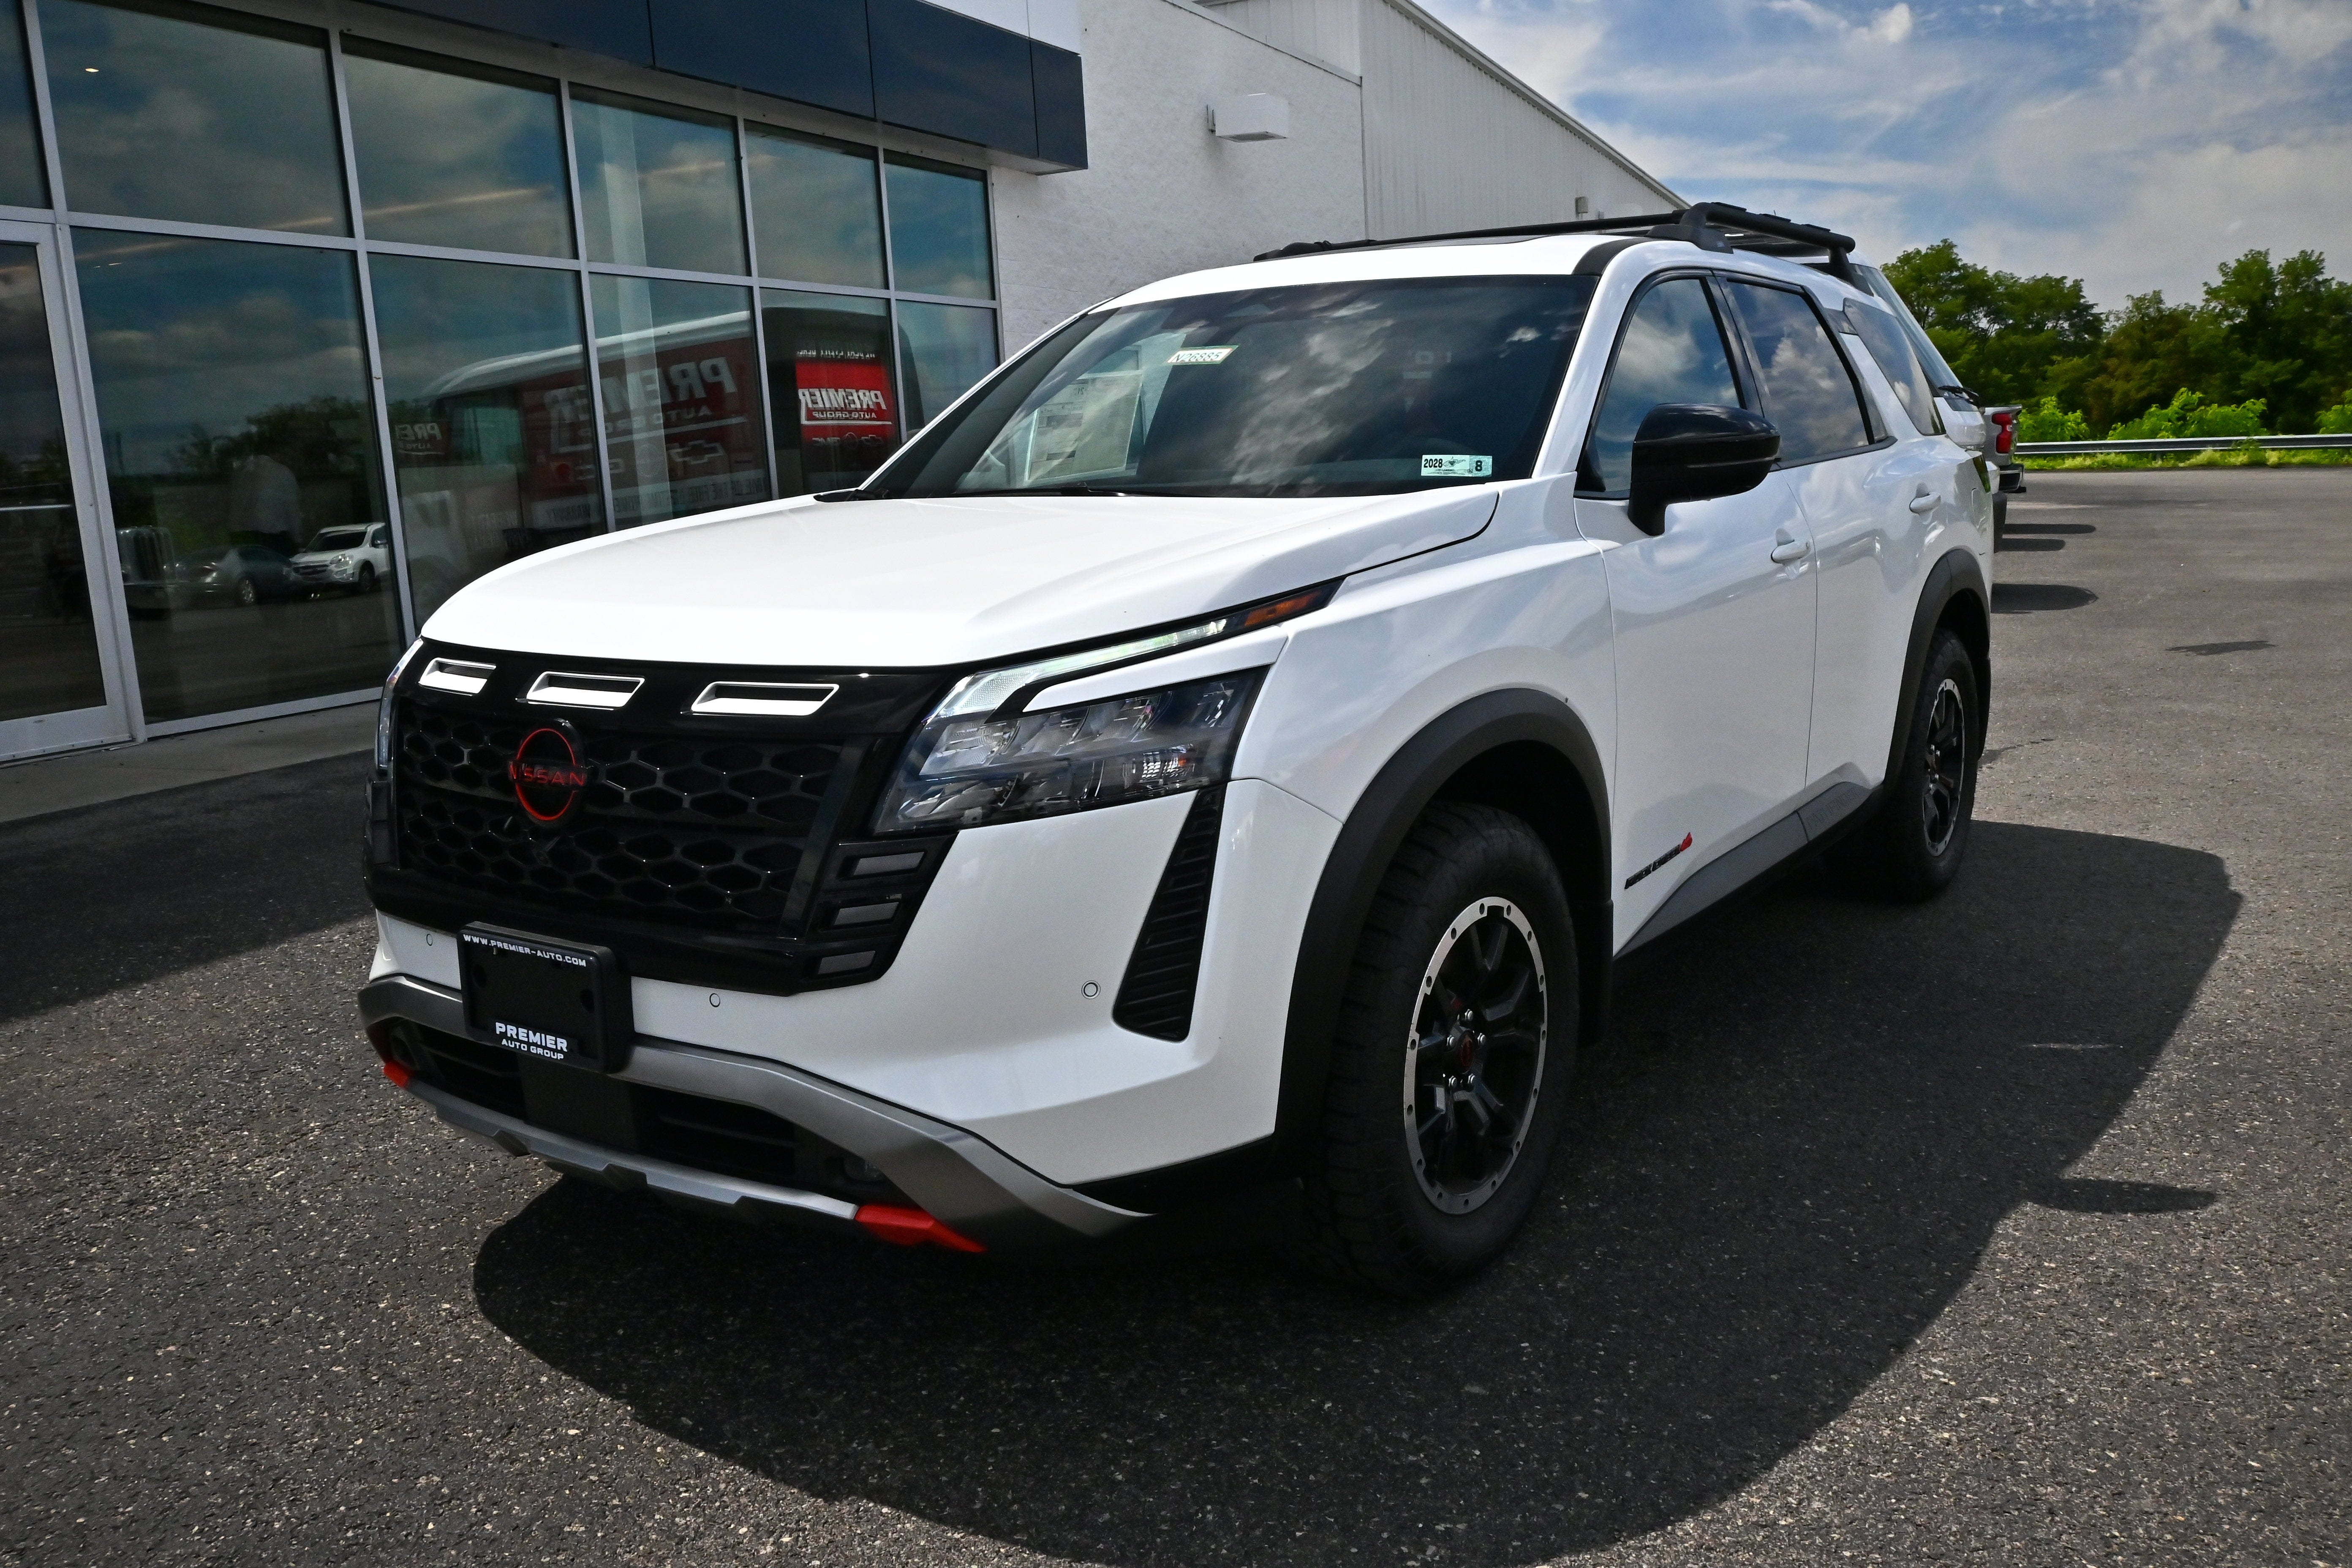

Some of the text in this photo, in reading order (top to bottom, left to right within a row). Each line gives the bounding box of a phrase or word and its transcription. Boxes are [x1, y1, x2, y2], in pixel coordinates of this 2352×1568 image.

[1424, 458, 1443, 468] 2028
[1475, 460, 1483, 472] 8
[463, 934, 586, 967] WWW.PREMIER-AUTO.COM
[495, 1022, 567, 1052] PREMIER
[501, 1039, 564, 1060] AUTO GROUP
